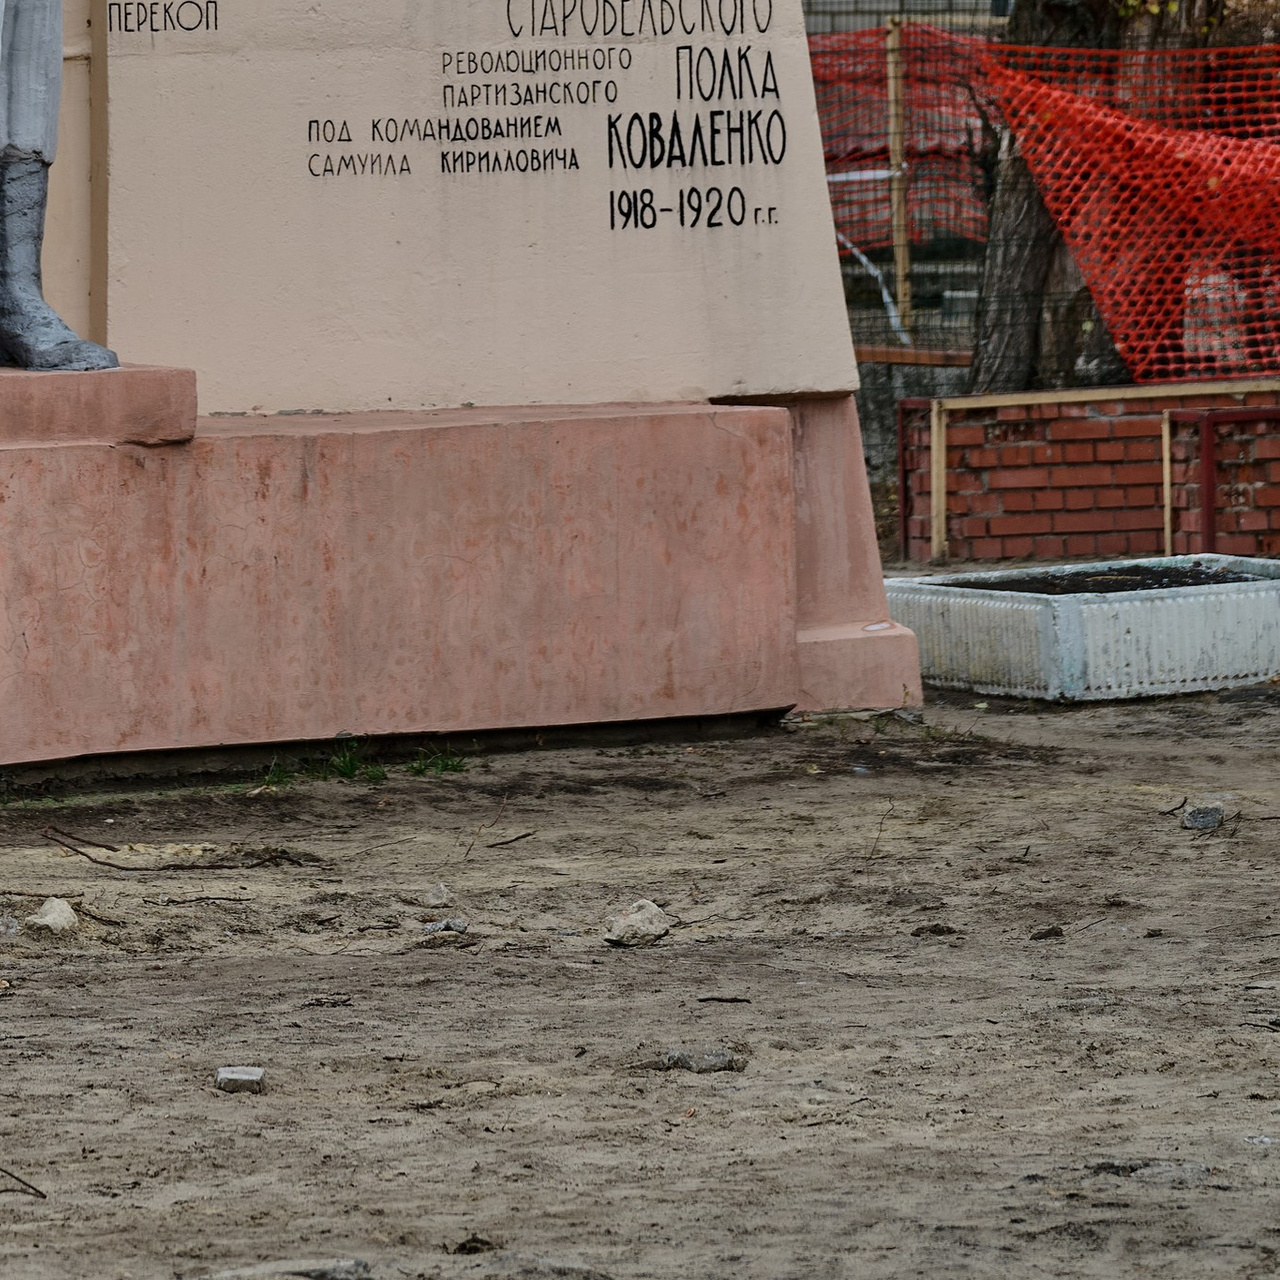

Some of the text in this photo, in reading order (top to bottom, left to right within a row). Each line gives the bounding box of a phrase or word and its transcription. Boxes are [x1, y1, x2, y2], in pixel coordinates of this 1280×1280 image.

[108, 0, 218, 32] ПЕРЕКОП
[442, 47, 632, 75] РЕВОЛЮЦИОННОГО
[675, 44, 781, 102] ПОЛКА
[442, 79, 618, 109] ПАРТИЗАНСКОГО
[308, 114, 563, 144] ПОД КОМАНДОВАНИЕМ
[607, 108, 787, 170] КОВАЛЕНКО
[308, 147, 580, 177] САМУИЛА КИРИЛЛОВИЧА
